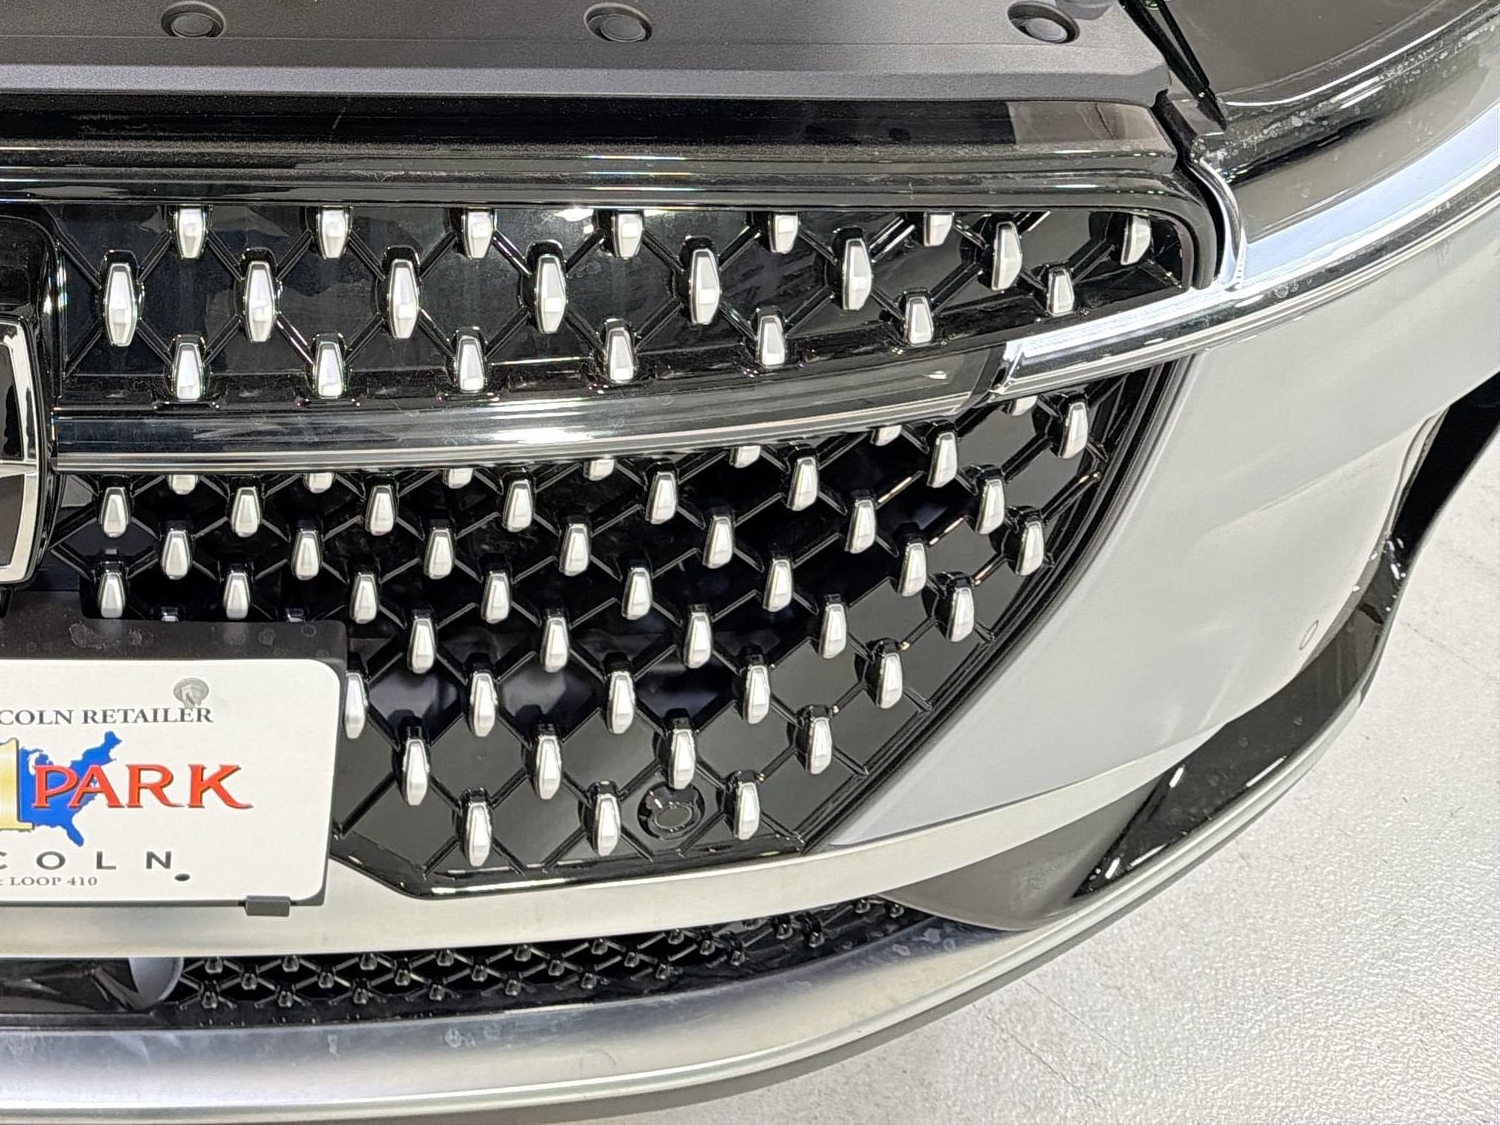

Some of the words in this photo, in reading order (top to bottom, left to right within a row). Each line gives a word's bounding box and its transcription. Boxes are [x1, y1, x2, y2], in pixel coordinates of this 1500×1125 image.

[81, 706, 214, 725] RETAILER
[32, 763, 253, 810] PARK
[8, 875, 63, 887] LOOP
[66, 875, 98, 887] 410
